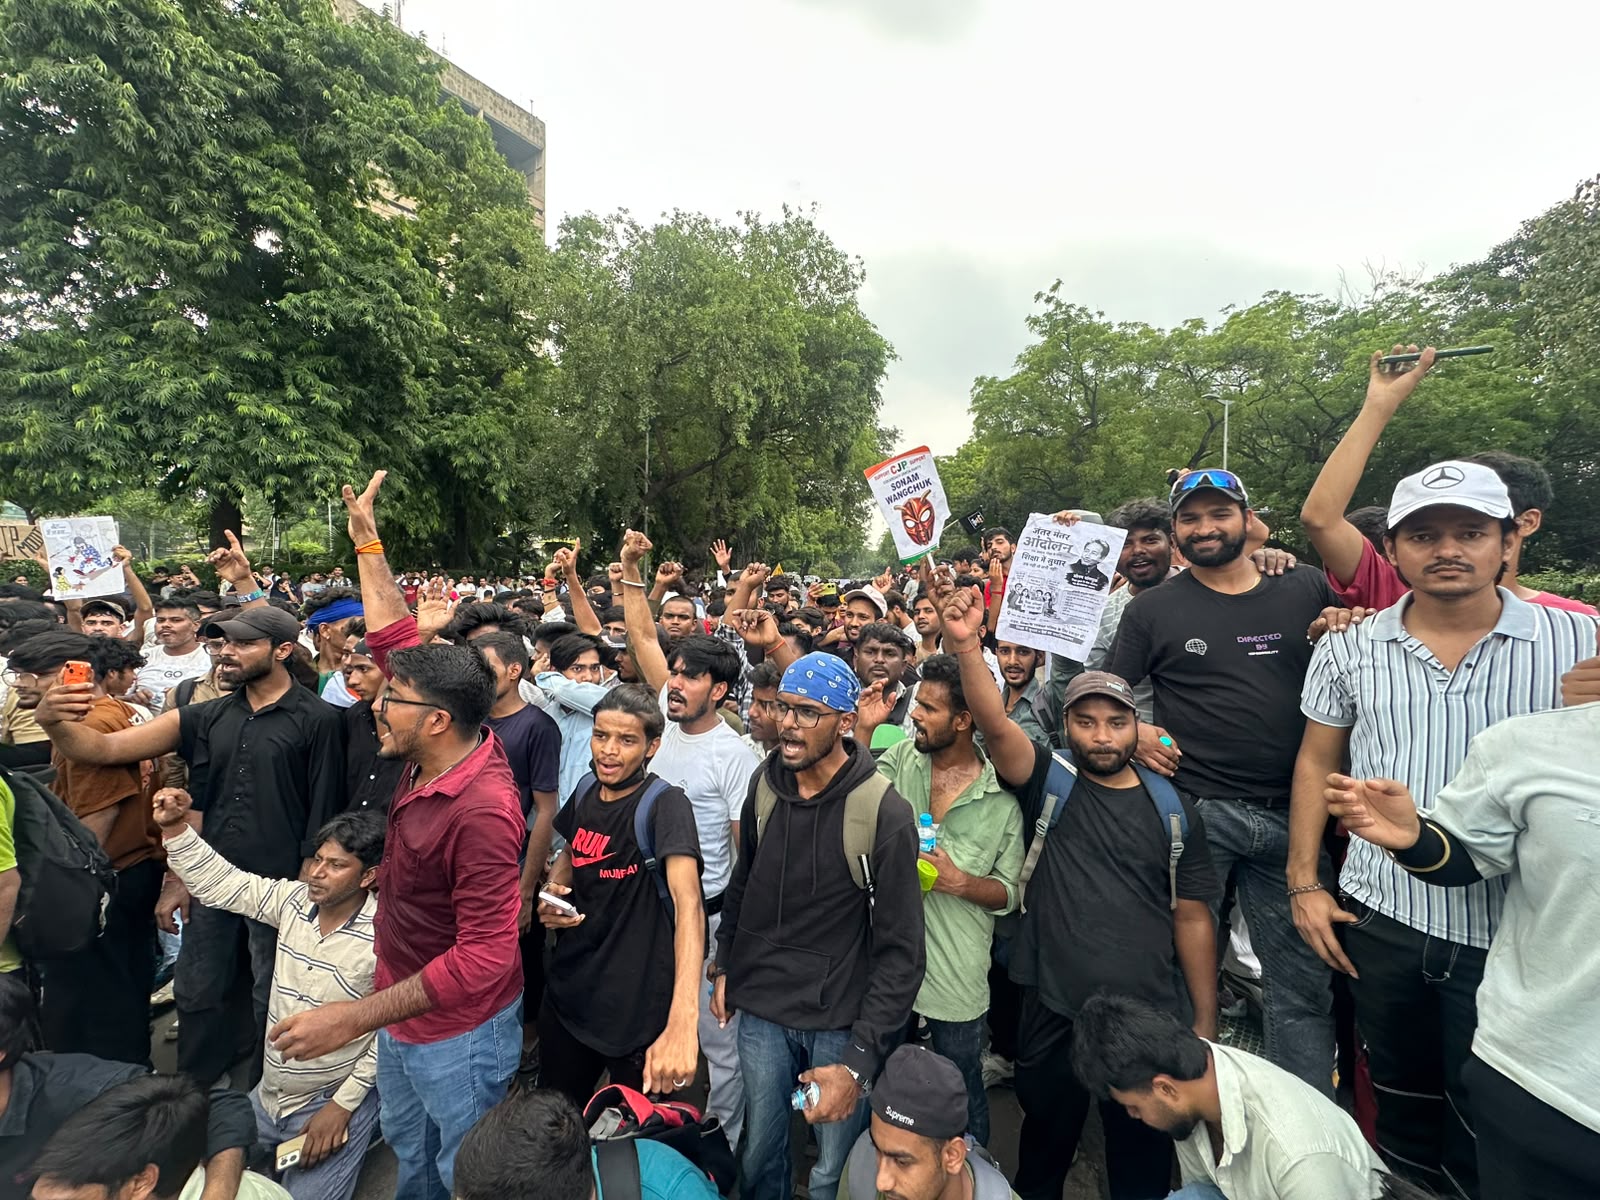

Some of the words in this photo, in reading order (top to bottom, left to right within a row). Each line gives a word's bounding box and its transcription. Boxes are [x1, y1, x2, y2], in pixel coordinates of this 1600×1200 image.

[890, 460, 908, 475] CJP
[890, 472, 920, 491] SONAM
[885, 478, 932, 505] WANGCHUK
[1023, 535, 1073, 553] आंदोलन
[1021, 551, 1039, 562] शिक्षा
[1047, 557, 1066, 568] सुधार
[1236, 632, 1282, 643] DIRECTED
[1255, 643, 1268, 651] BY
[164, 670, 183, 679] GO
[572, 827, 611, 859] RUN
[885, 1105, 915, 1126] Supreme
